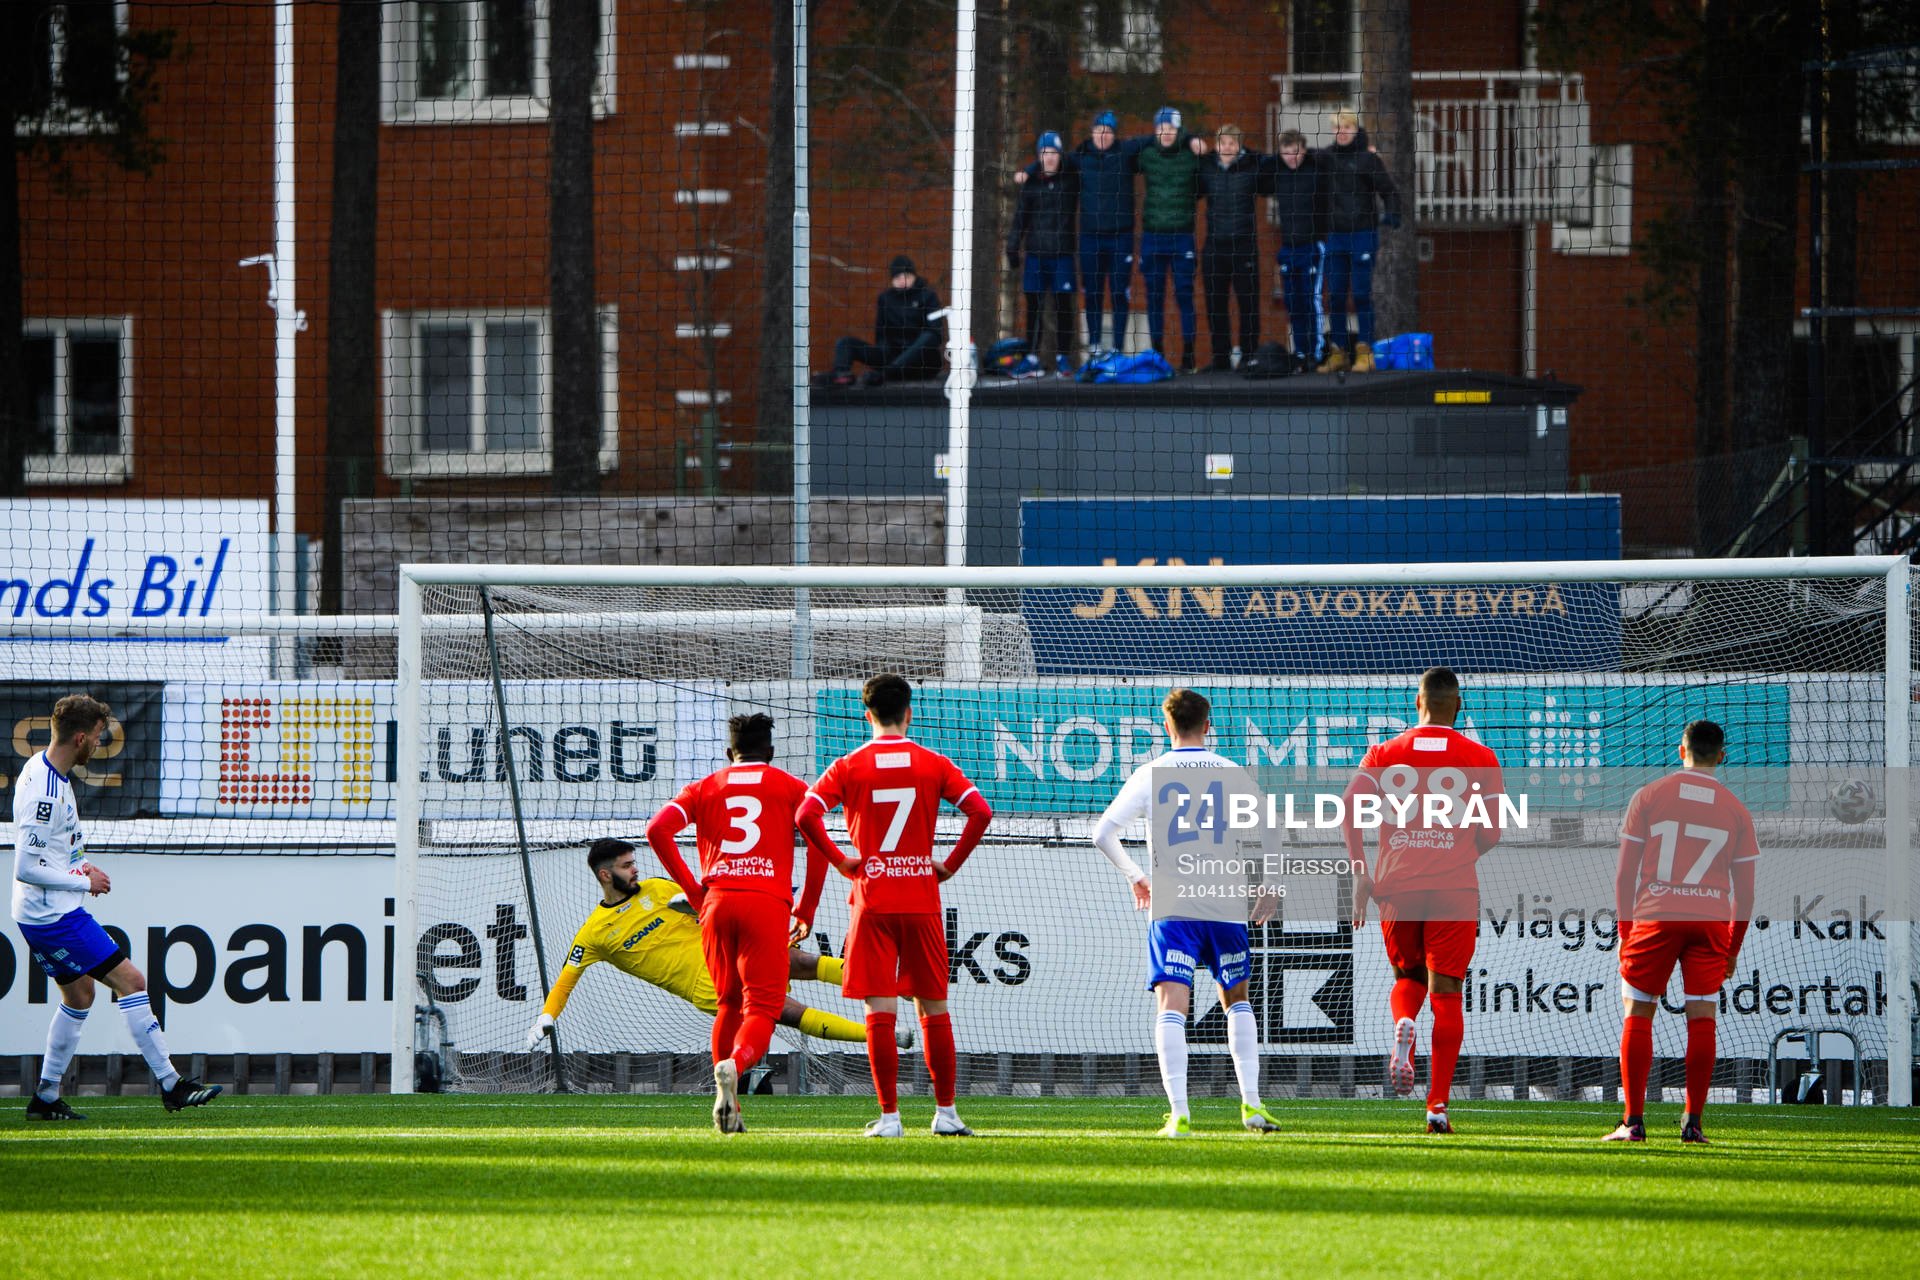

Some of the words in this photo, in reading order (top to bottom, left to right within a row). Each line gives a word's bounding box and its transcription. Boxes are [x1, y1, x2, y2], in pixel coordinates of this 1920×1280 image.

[131, 538, 230, 617] Bil
[386, 720, 657, 783] Lunet
[872, 787, 916, 852] 7
[1159, 781, 1227, 846] 24
[1380, 764, 1468, 825] 88
[720, 795, 763, 854] 3
[1408, 840, 1454, 849] REKLAM
[1410, 829, 1454, 841] TRYCK&
[1650, 820, 1729, 884] 17
[729, 866, 774, 877] REKLAM
[730, 856, 774, 869] TRYCK&
[886, 856, 932, 867] TRYCK&
[886, 866, 933, 877] REKLAM
[1476, 893, 1620, 951] vlägg
[1793, 894, 1886, 940] Kak
[1672, 887, 1721, 899] REKLAM
[623, 917, 665, 950] SCANIA
[0, 898, 527, 1031] paniet
